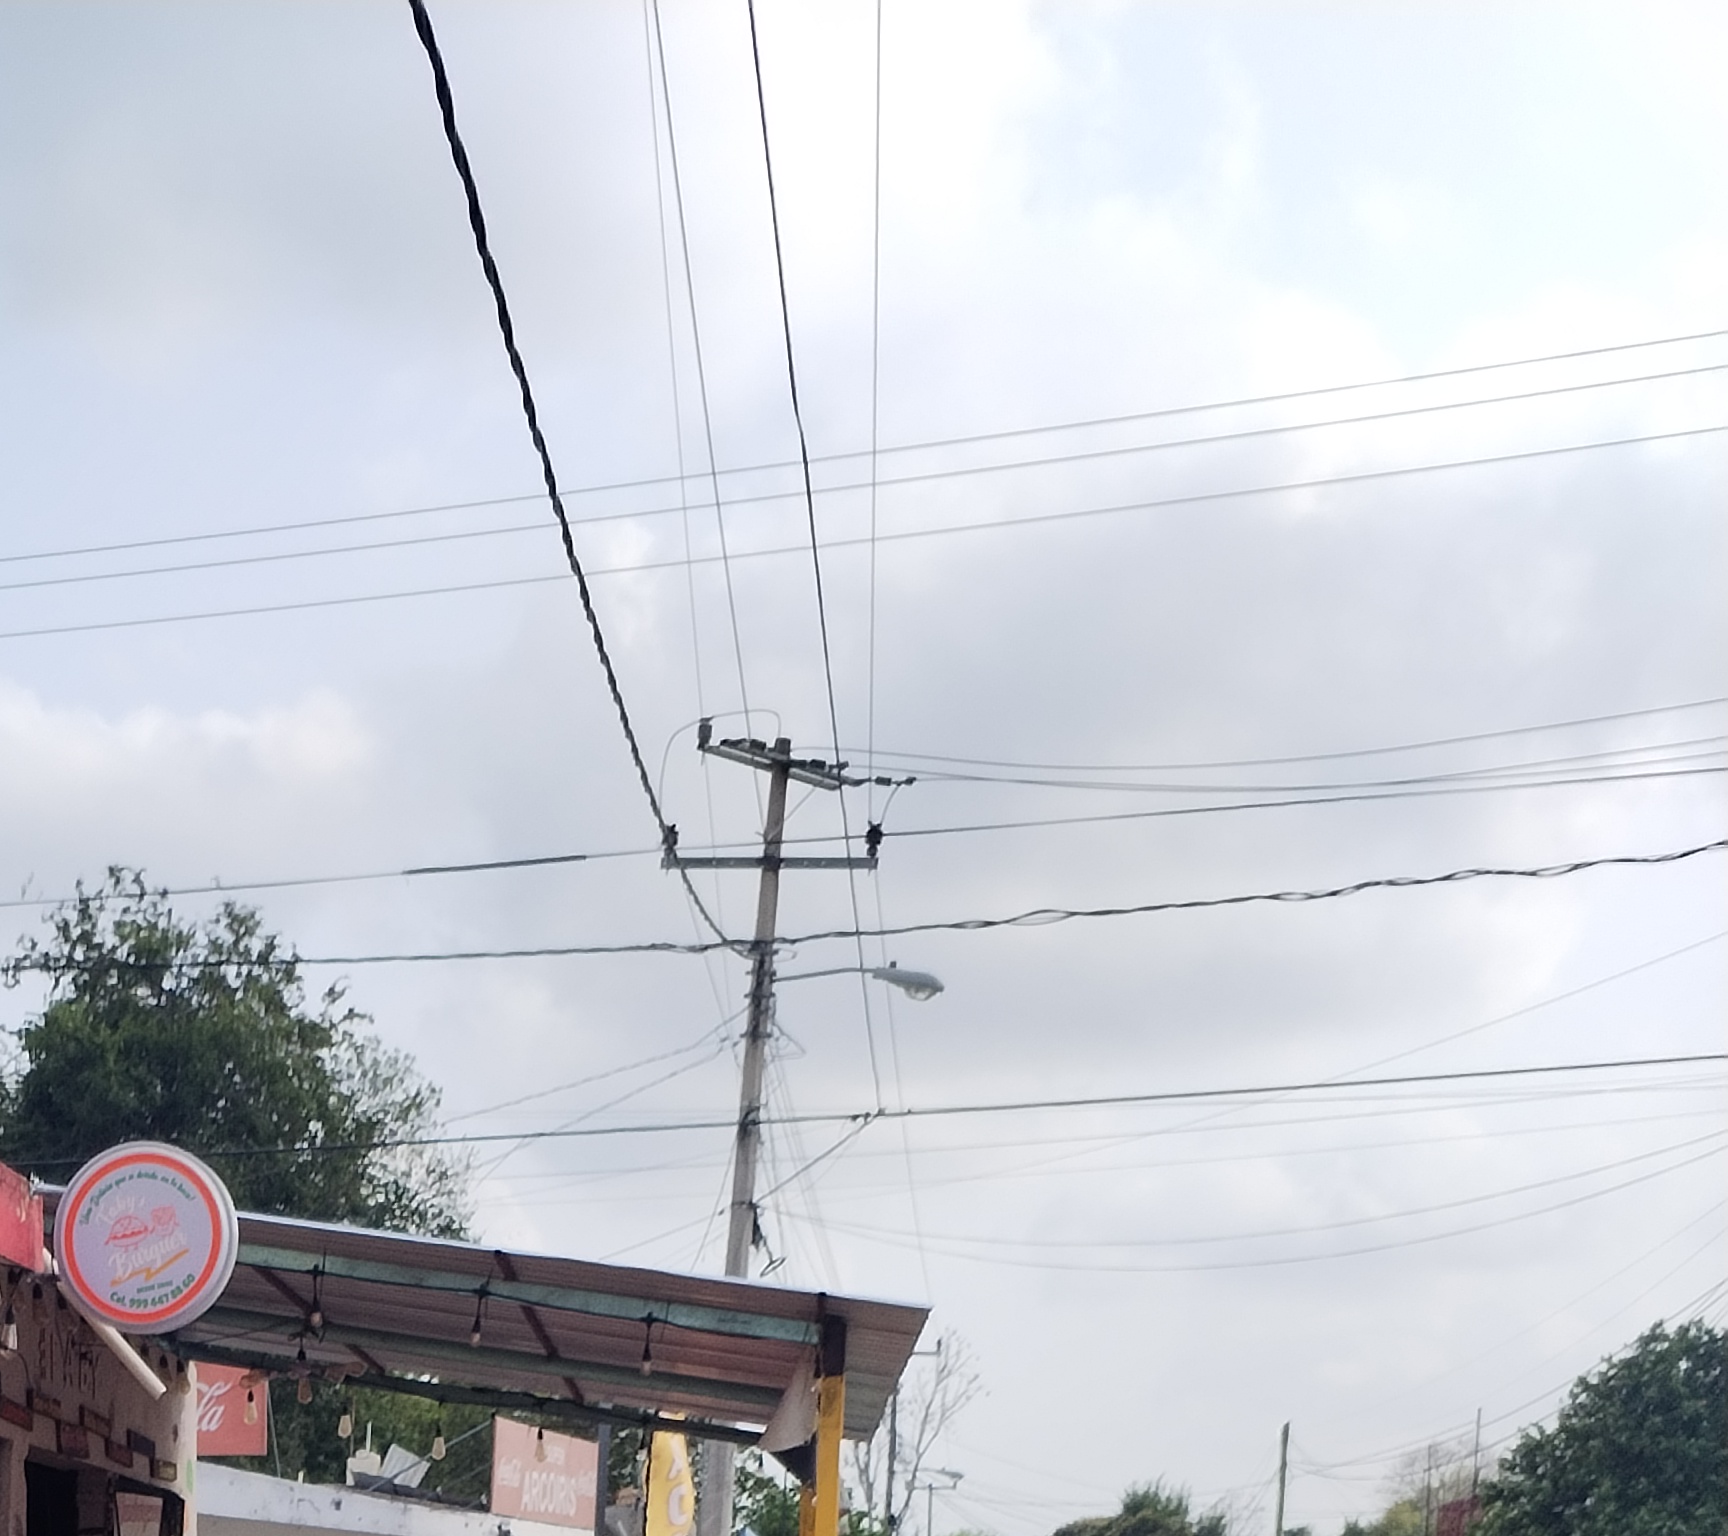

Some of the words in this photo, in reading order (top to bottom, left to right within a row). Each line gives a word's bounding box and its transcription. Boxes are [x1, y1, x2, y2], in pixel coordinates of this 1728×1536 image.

[108, 1230, 188, 1281] Burguer
[129, 1297, 148, 1309] 999
[519, 1469, 577, 1518] ARCOIRIS
